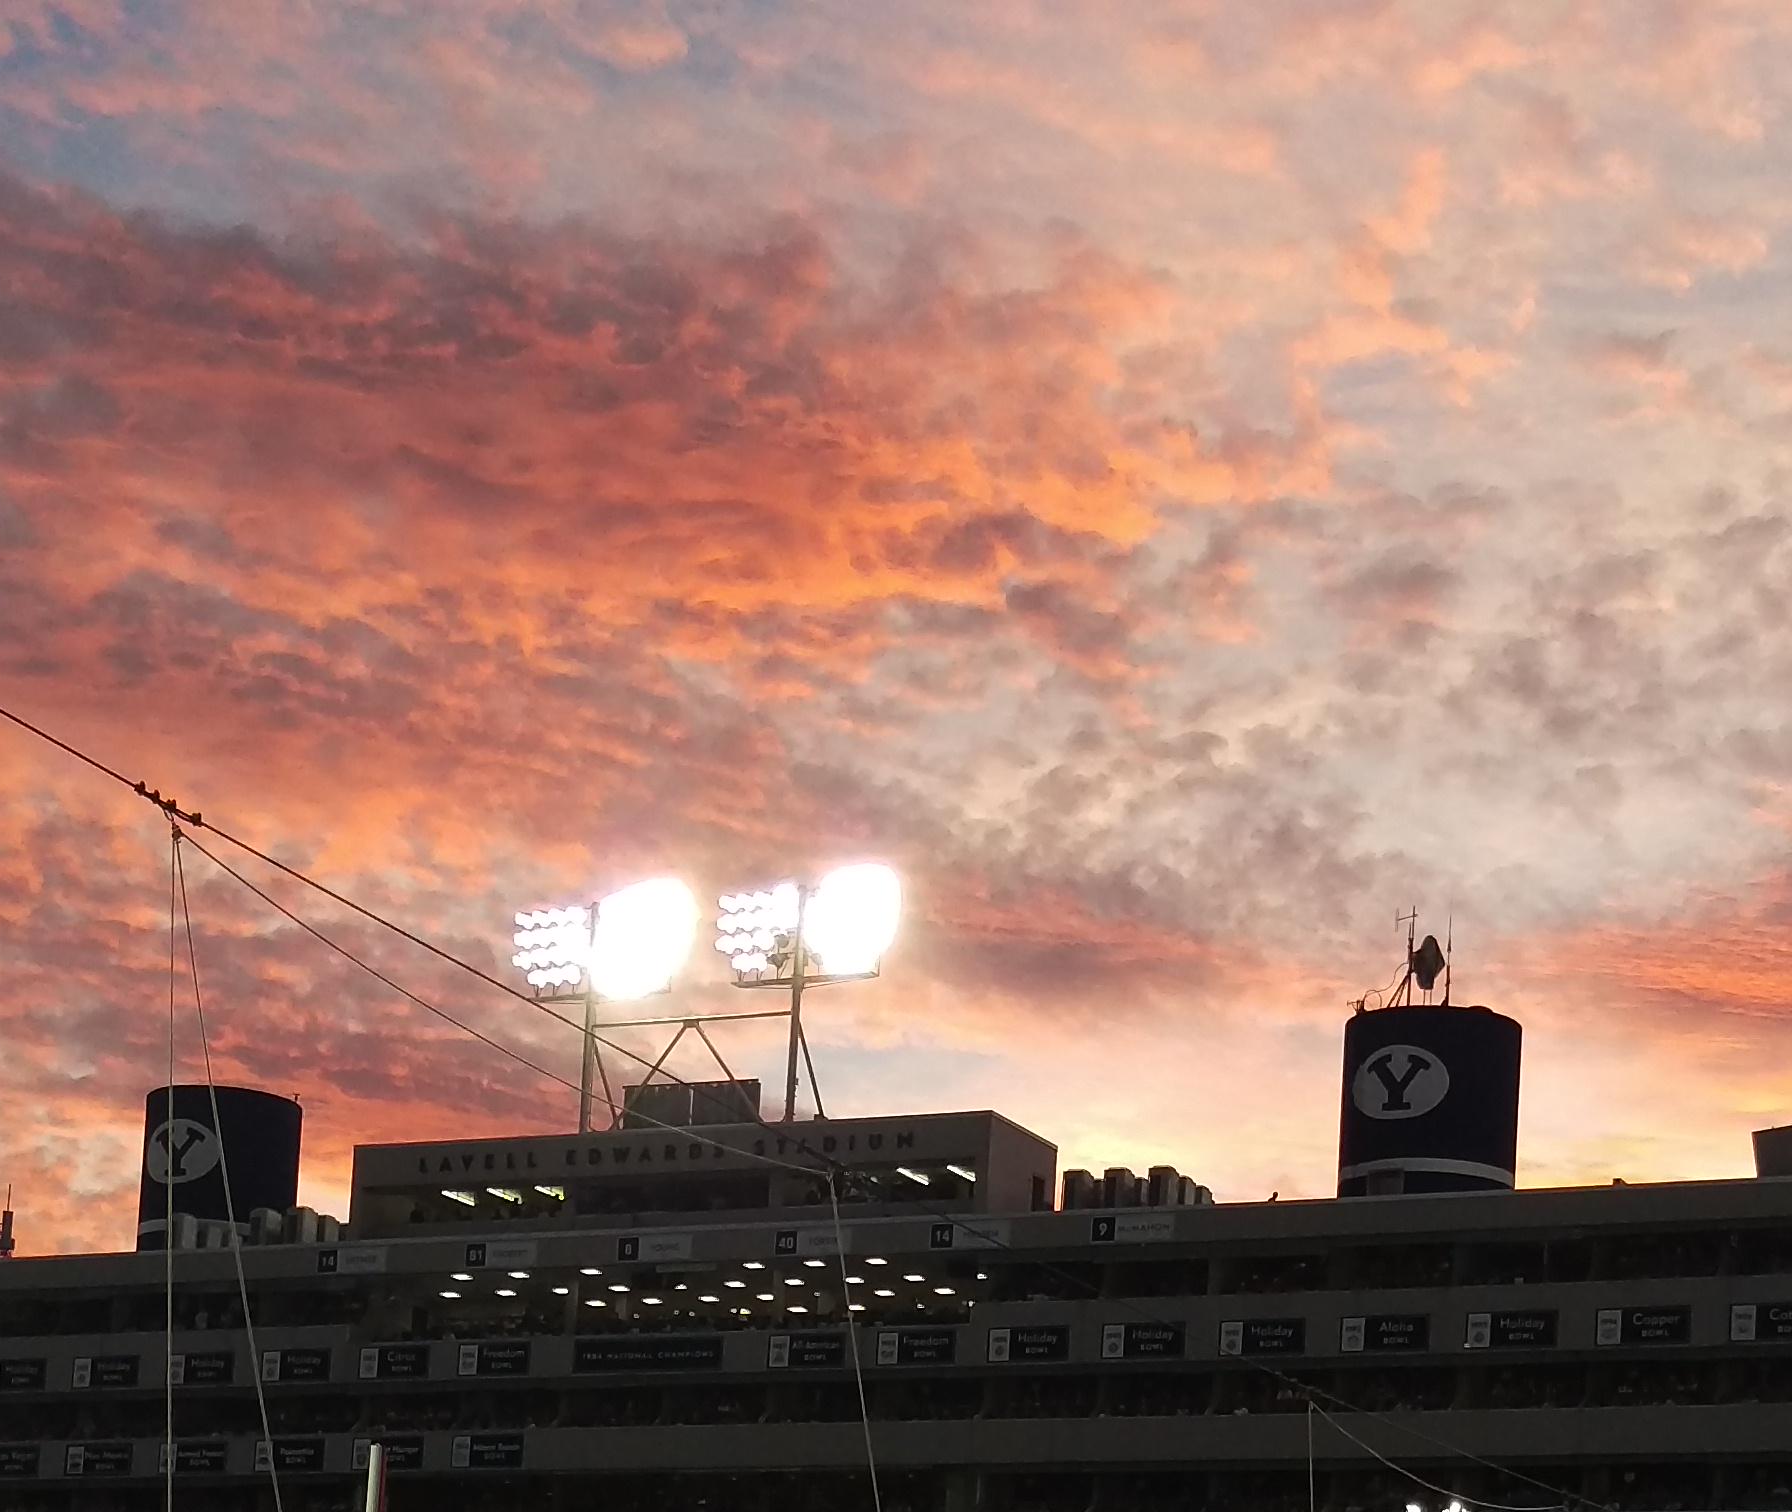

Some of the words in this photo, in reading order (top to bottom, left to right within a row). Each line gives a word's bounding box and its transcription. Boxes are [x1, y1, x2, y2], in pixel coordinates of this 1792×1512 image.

[1367, 1053, 1430, 1111] Y
[156, 1126, 206, 1177] Y
[419, 1151, 537, 1174] LAVELL
[566, 1144, 724, 1166] EDWARDS
[754, 1133, 914, 1156] STADIUM
[1099, 1222, 1108, 1235] 9
[935, 1230, 950, 1242] 14
[779, 1236, 794, 1249] 40
[321, 1255, 334, 1267] 14
[1500, 1317, 1546, 1330] Holiday
[1632, 1312, 1680, 1326] Copper
[1251, 1325, 1295, 1338] Holiday
[1379, 1321, 1414, 1333] Aloha
[1641, 1328, 1670, 1337] BOWL
[903, 1335, 949, 1347] Freedom
[1018, 1332, 1058, 1345] Holiday
[1131, 1328, 1176, 1342] Holiday
[1383, 1336, 1409, 1344] BOWL
[1508, 1332, 1535, 1340] BOWL
[1025, 1346, 1049, 1354] BOWL
[1140, 1343, 1165, 1351] BOWL
[1259, 1340, 1284, 1348] BOWL
[483, 1346, 525, 1359] Freedom
[913, 1350, 937, 1359] BOWL
